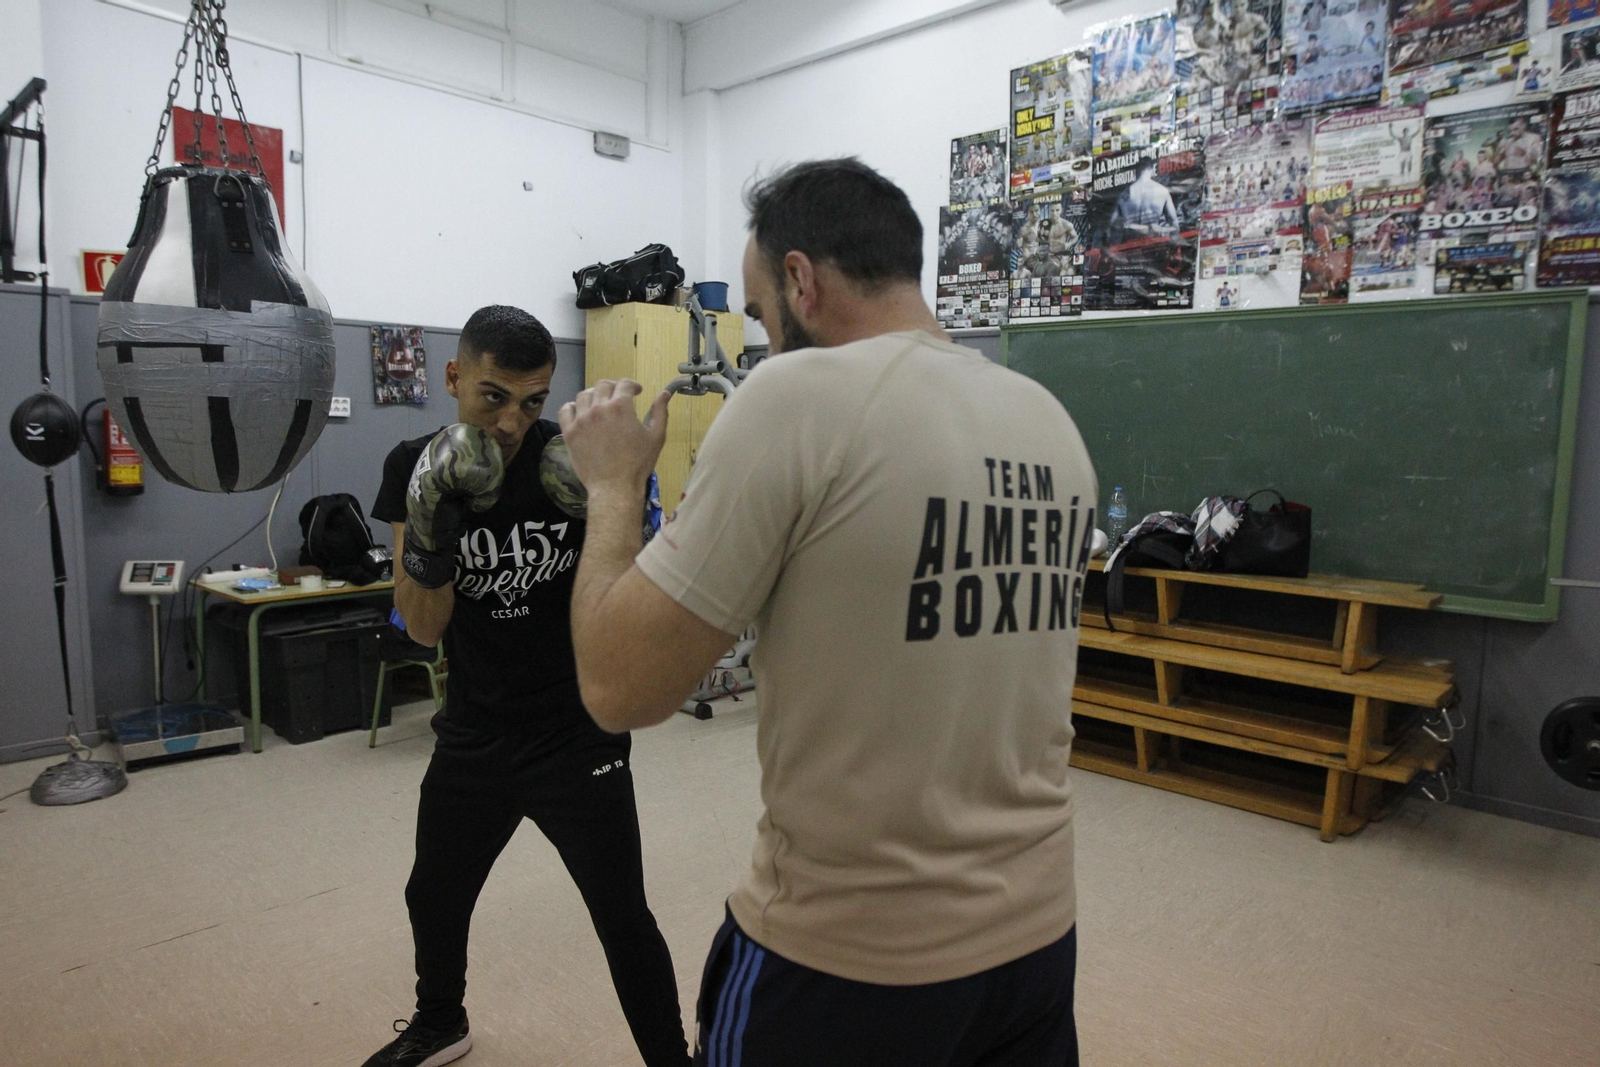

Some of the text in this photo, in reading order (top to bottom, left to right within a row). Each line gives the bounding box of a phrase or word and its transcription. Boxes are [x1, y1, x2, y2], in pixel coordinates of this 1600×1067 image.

[1096, 160, 1106, 174] LA
[1107, 150, 1139, 169] BATALLA
[1418, 205, 1538, 231] BOXEO
[959, 262, 983, 275] BOXEO
[985, 457, 1054, 502] TEAM
[913, 496, 1094, 580] ALMERÍA
[906, 572, 1082, 642] BOXING
